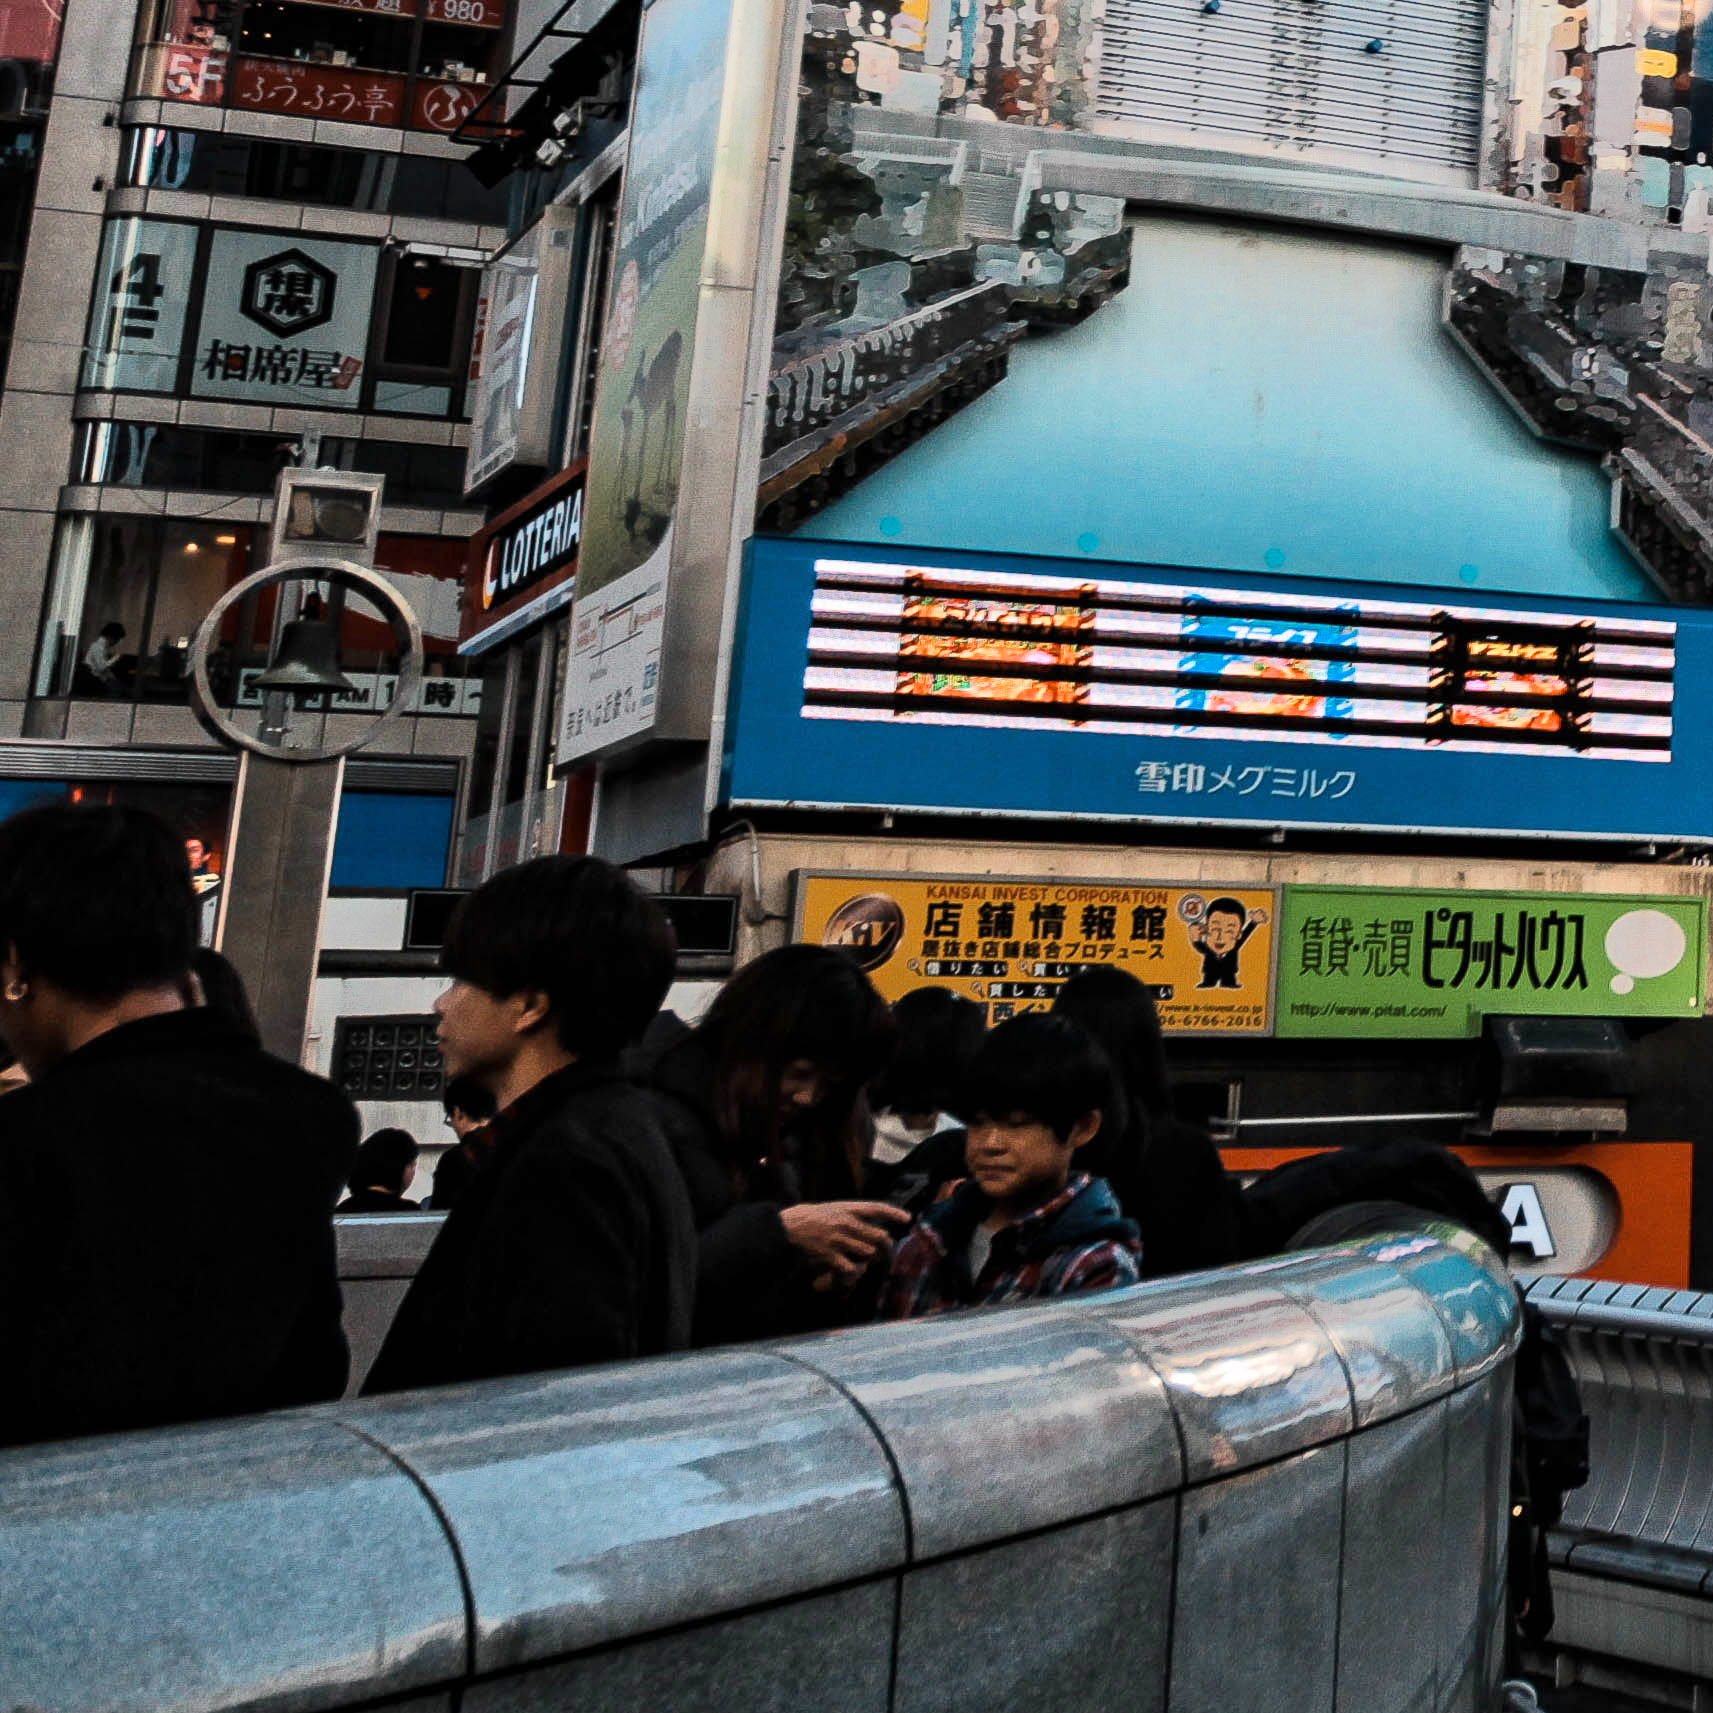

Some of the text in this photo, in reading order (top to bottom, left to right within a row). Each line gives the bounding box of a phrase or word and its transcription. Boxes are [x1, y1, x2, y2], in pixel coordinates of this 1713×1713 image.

[167, 54, 226, 97] 5F
[242, 76, 395, 122] ふうふう亭
[201, 338, 343, 390] 相席屋
[500, 487, 583, 590] LOTTERIA
[1133, 759, 1357, 801] 雪印メグミルク
[926, 884, 1170, 905] KANSAI INVEST CORPORATION
[922, 901, 1168, 943] 店舗情報館
[921, 939, 1166, 961] 居抜き店舗総合プロデュース
[1300, 906, 1589, 990] 賃貸・売買 ピタットハウス
[926, 962, 1008, 977] 借りたい
[1290, 1003, 1449, 1020] http://www.pitat.com/
